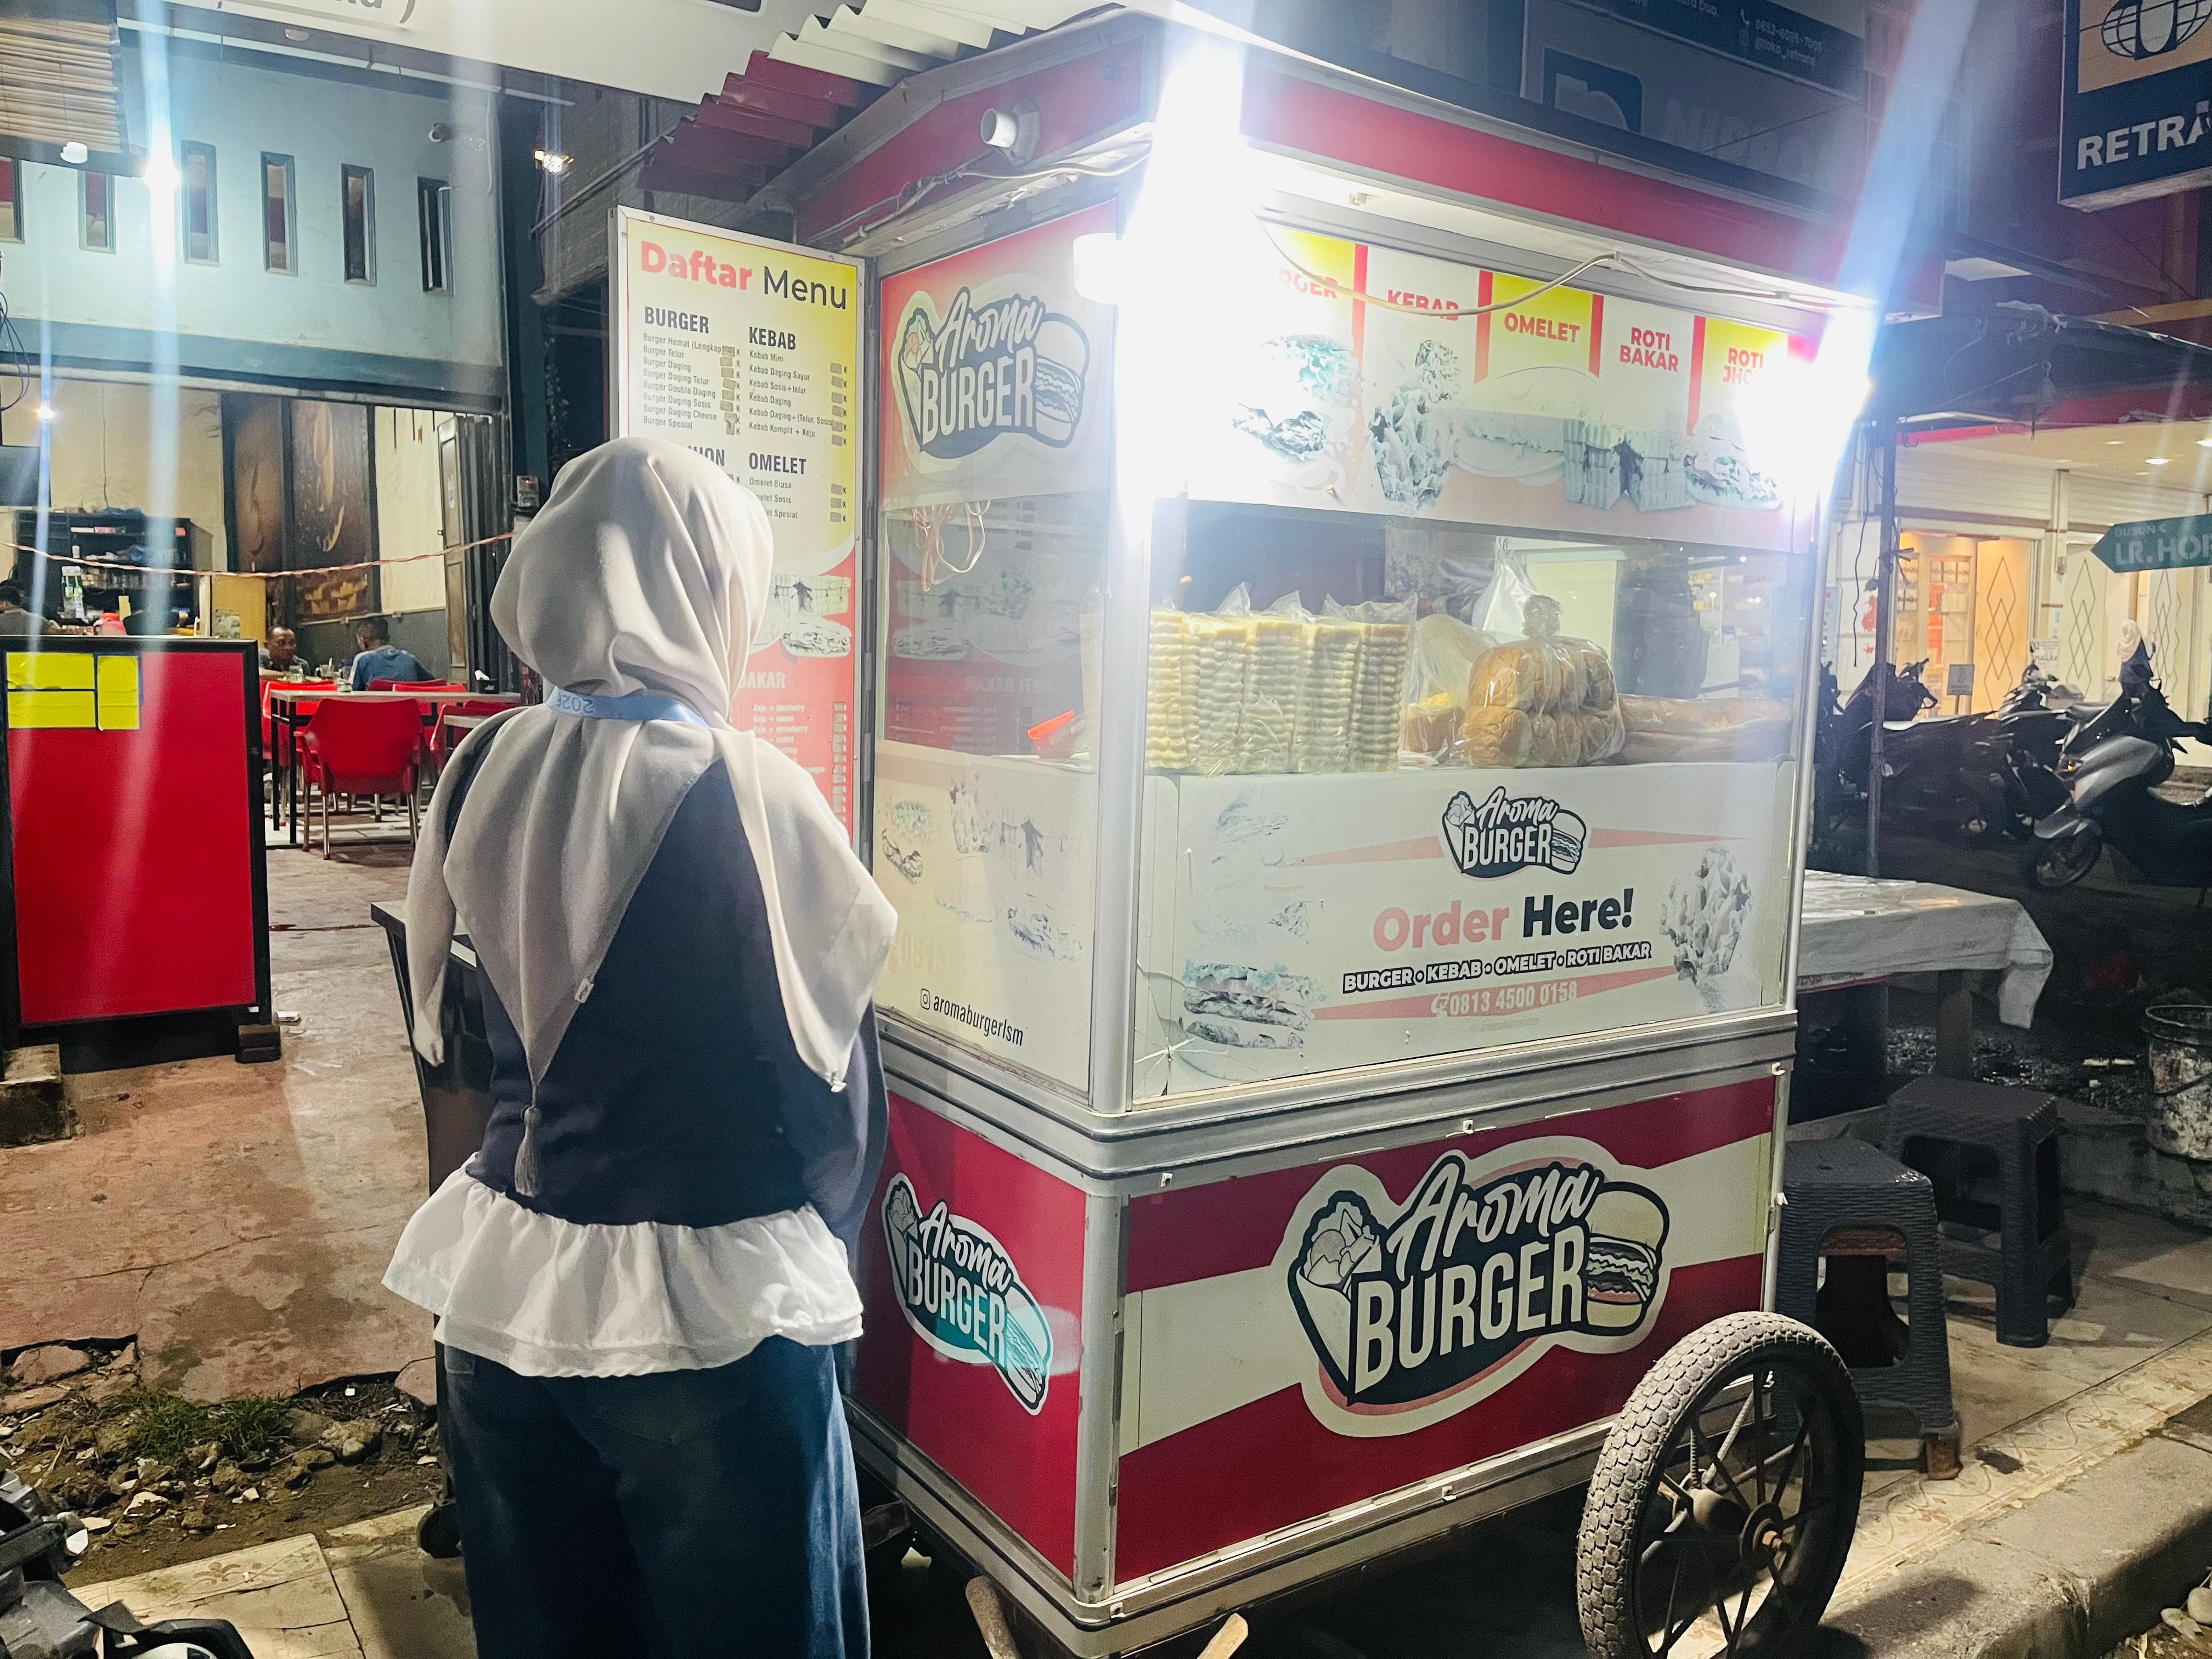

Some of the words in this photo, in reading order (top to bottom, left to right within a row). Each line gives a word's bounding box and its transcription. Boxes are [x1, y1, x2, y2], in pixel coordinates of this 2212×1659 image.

[641, 240, 752, 291] Daftar
[764, 266, 847, 309] Menu
[644, 306, 709, 334] BURGER
[1504, 312, 1580, 343] OMELET
[644, 333, 665, 344] Burger
[668, 337, 689, 348] Hemat
[749, 326, 796, 350] KEBAB
[935, 291, 1043, 372] Aroma
[1630, 327, 1671, 351] ROTI
[644, 345, 665, 356] Burger
[668, 348, 684, 358] Telur
[749, 350, 768, 360] Kebab
[770, 353, 783, 362] Mini
[1619, 345, 1679, 373] BAKAR
[1728, 347, 1764, 369] ROTI
[644, 357, 665, 368] Burger
[668, 360, 691, 373] Daging
[749, 364, 768, 374] Kebab
[770, 368, 791, 379] Daging
[793, 371, 810, 381] Sayur
[644, 369, 665, 380] Burger
[668, 372, 691, 383] Daging
[693, 376, 709, 385] Telur
[749, 379, 768, 388] Kebab
[644, 380, 665, 392] Burger
[668, 384, 691, 394] Double
[693, 387, 715, 399] Daging
[644, 392, 665, 403] Burger
[668, 396, 691, 407] Daging
[693, 399, 711, 408] Sosis
[749, 393, 768, 403] Kebab
[770, 396, 791, 408] Daging
[922, 346, 1036, 445] BURGER
[644, 404, 665, 415] Burger
[668, 407, 691, 419] Daging
[693, 410, 716, 420] Cheese
[644, 416, 665, 427] Burger
[668, 419, 692, 428] Spesial
[749, 407, 768, 417] Kebab
[749, 422, 768, 431] Kebab
[770, 425, 793, 435] Komplit
[803, 428, 815, 438] Keju
[749, 453, 806, 475] OMELET
[749, 477, 772, 487] Omelet
[774, 480, 792, 489] Biasa
[774, 495, 791, 504] Sosis
[774, 510, 798, 519] Spesial
[1476, 788, 1559, 831] Aroma
[1463, 823, 1552, 870] BURGER
[1373, 900, 1510, 952] Order
[1523, 888, 1634, 938] Here!
[1343, 969, 1414, 992] BURGER
[1426, 961, 1482, 982] KEBAB
[1494, 953, 1555, 974] OMELET
[1566, 949, 1600, 967] ROTI
[1603, 943, 1651, 962] BAKAR
[1449, 991, 1491, 1016] 0813
[1496, 986, 1534, 1010] 4500
[1540, 980, 1577, 1005] 0158
[1387, 1168, 1598, 1282] Aroma
[919, 1201, 1011, 1293] Aroma
[909, 1238, 1006, 1367] BURGER
[1355, 1224, 1588, 1395] BURGER
